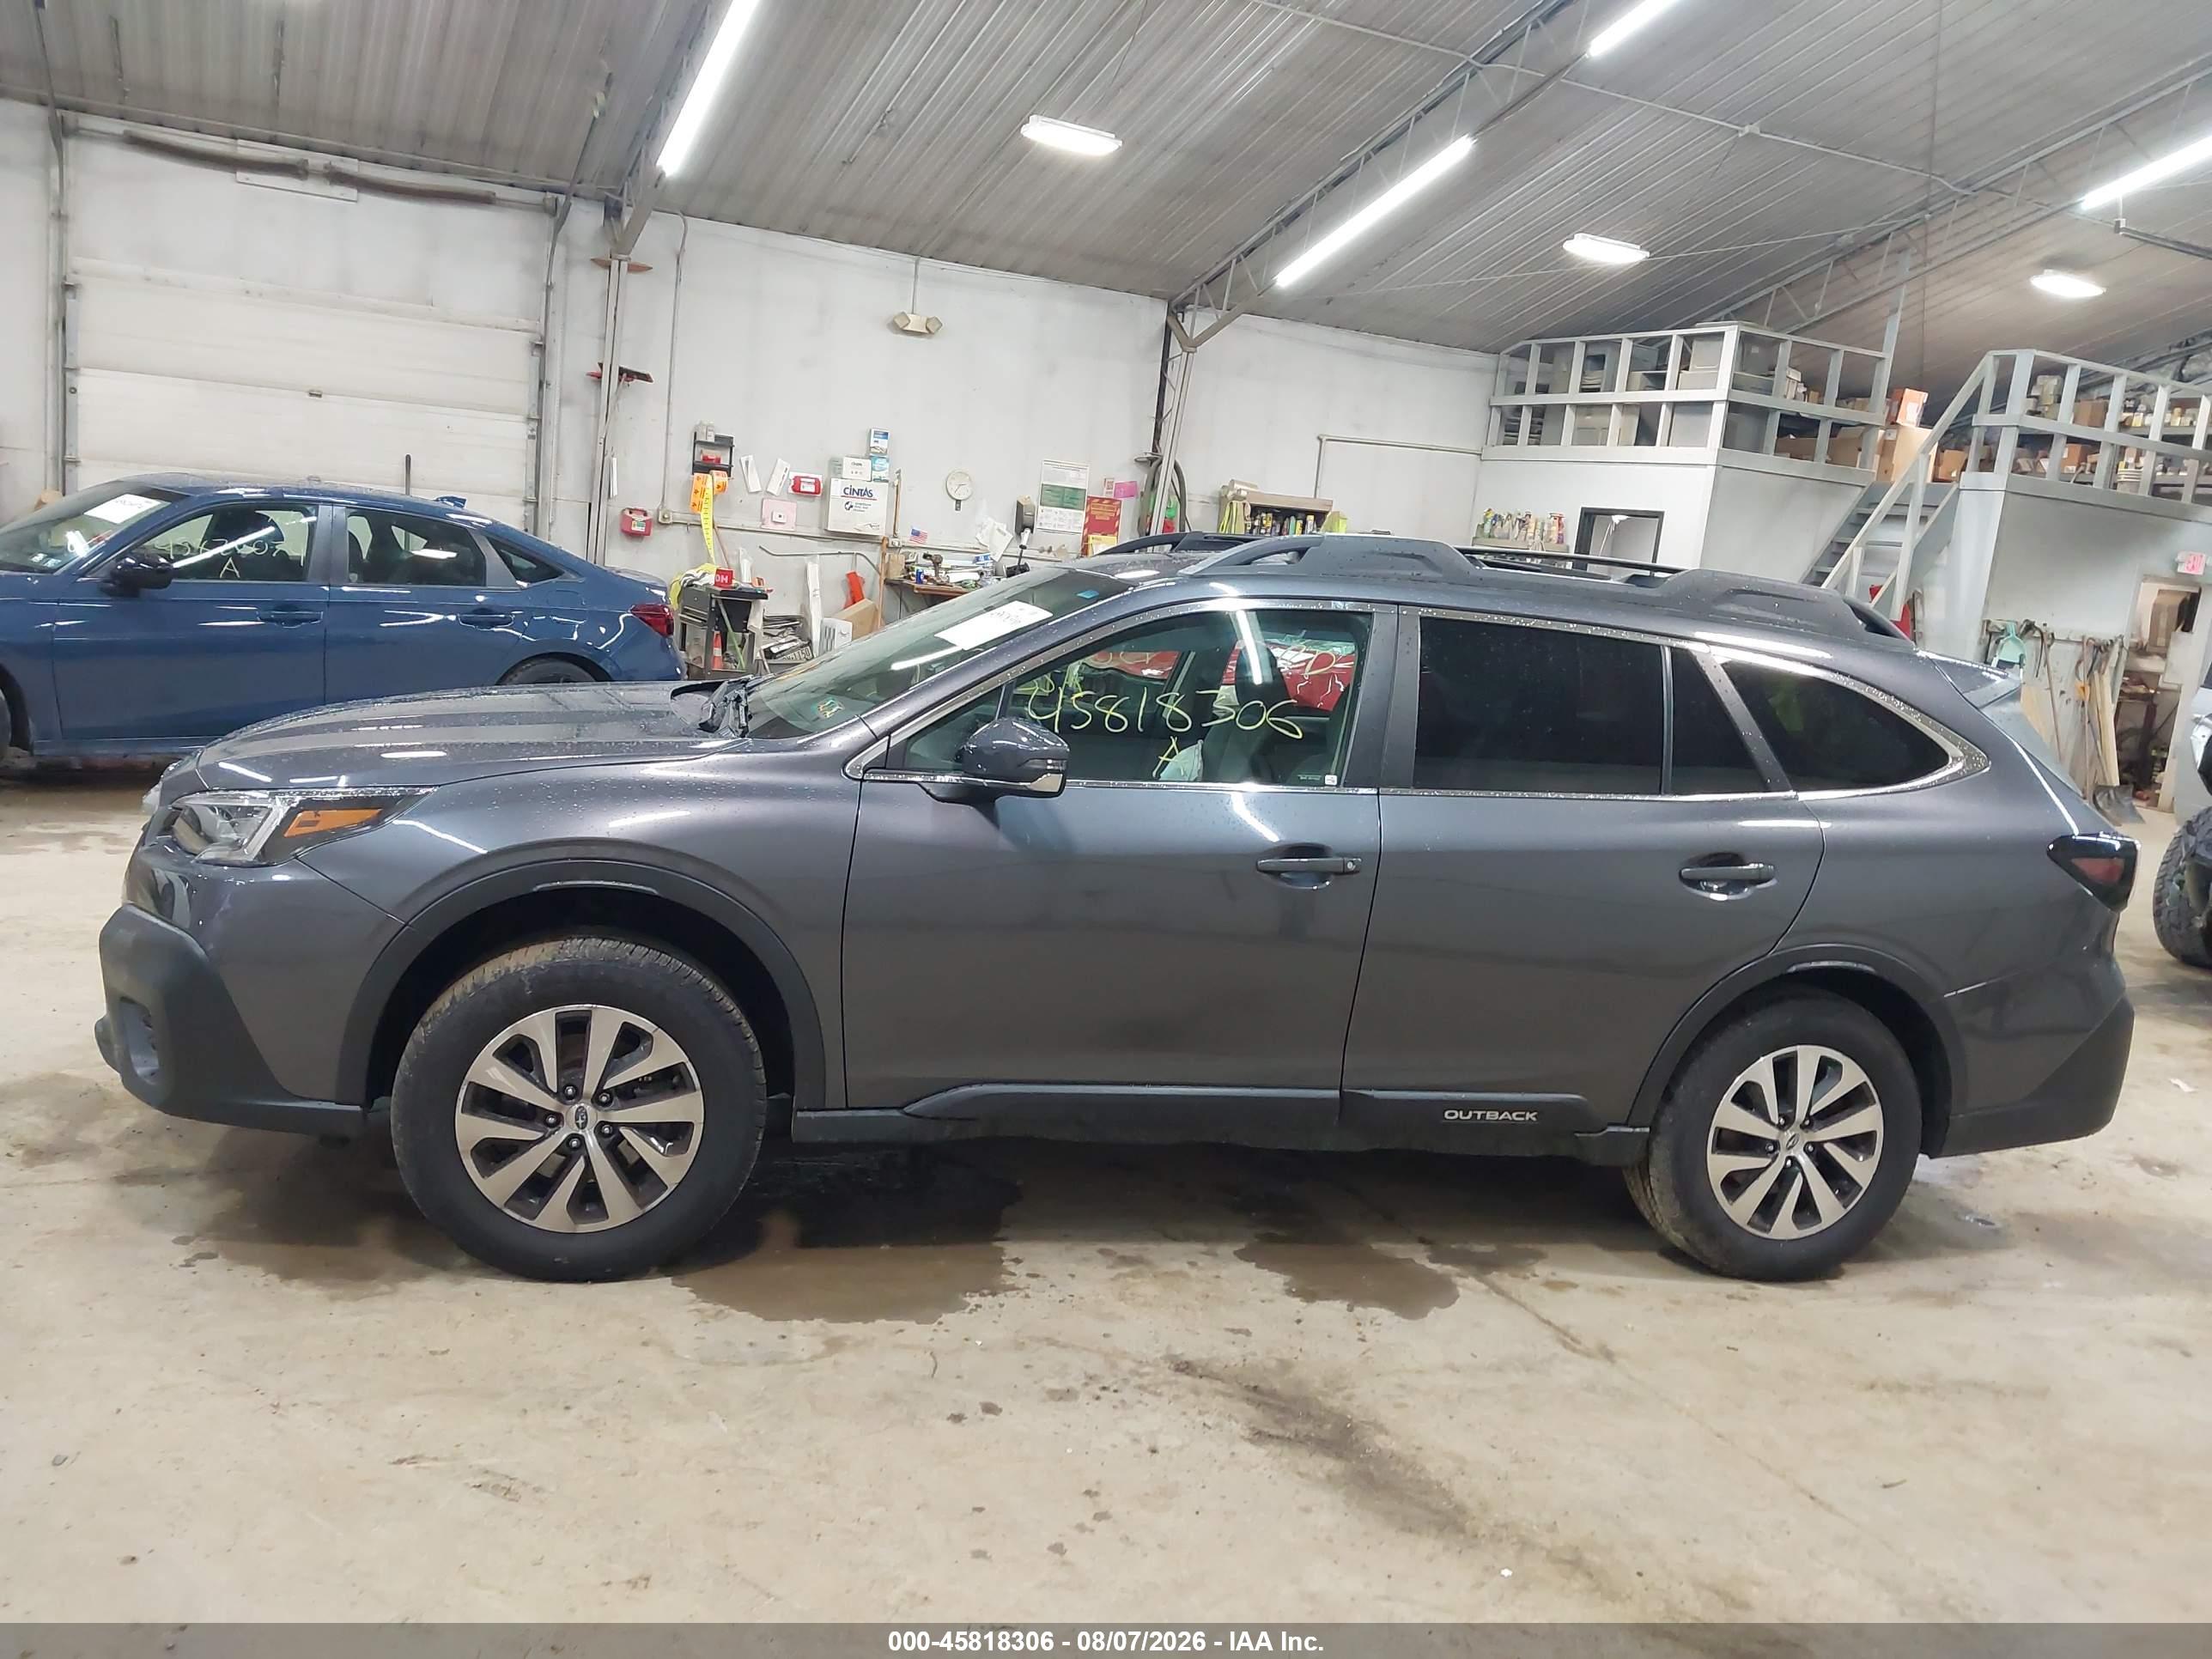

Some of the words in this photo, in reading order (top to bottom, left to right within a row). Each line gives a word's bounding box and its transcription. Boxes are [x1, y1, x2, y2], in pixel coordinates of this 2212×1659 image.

[842, 484, 873, 497] CINTAS
[219, 556, 240, 579] A
[1027, 686, 1304, 739] 45818306
[1152, 735, 1180, 778] A
[1443, 1109, 1539, 1121] OUTBACK
